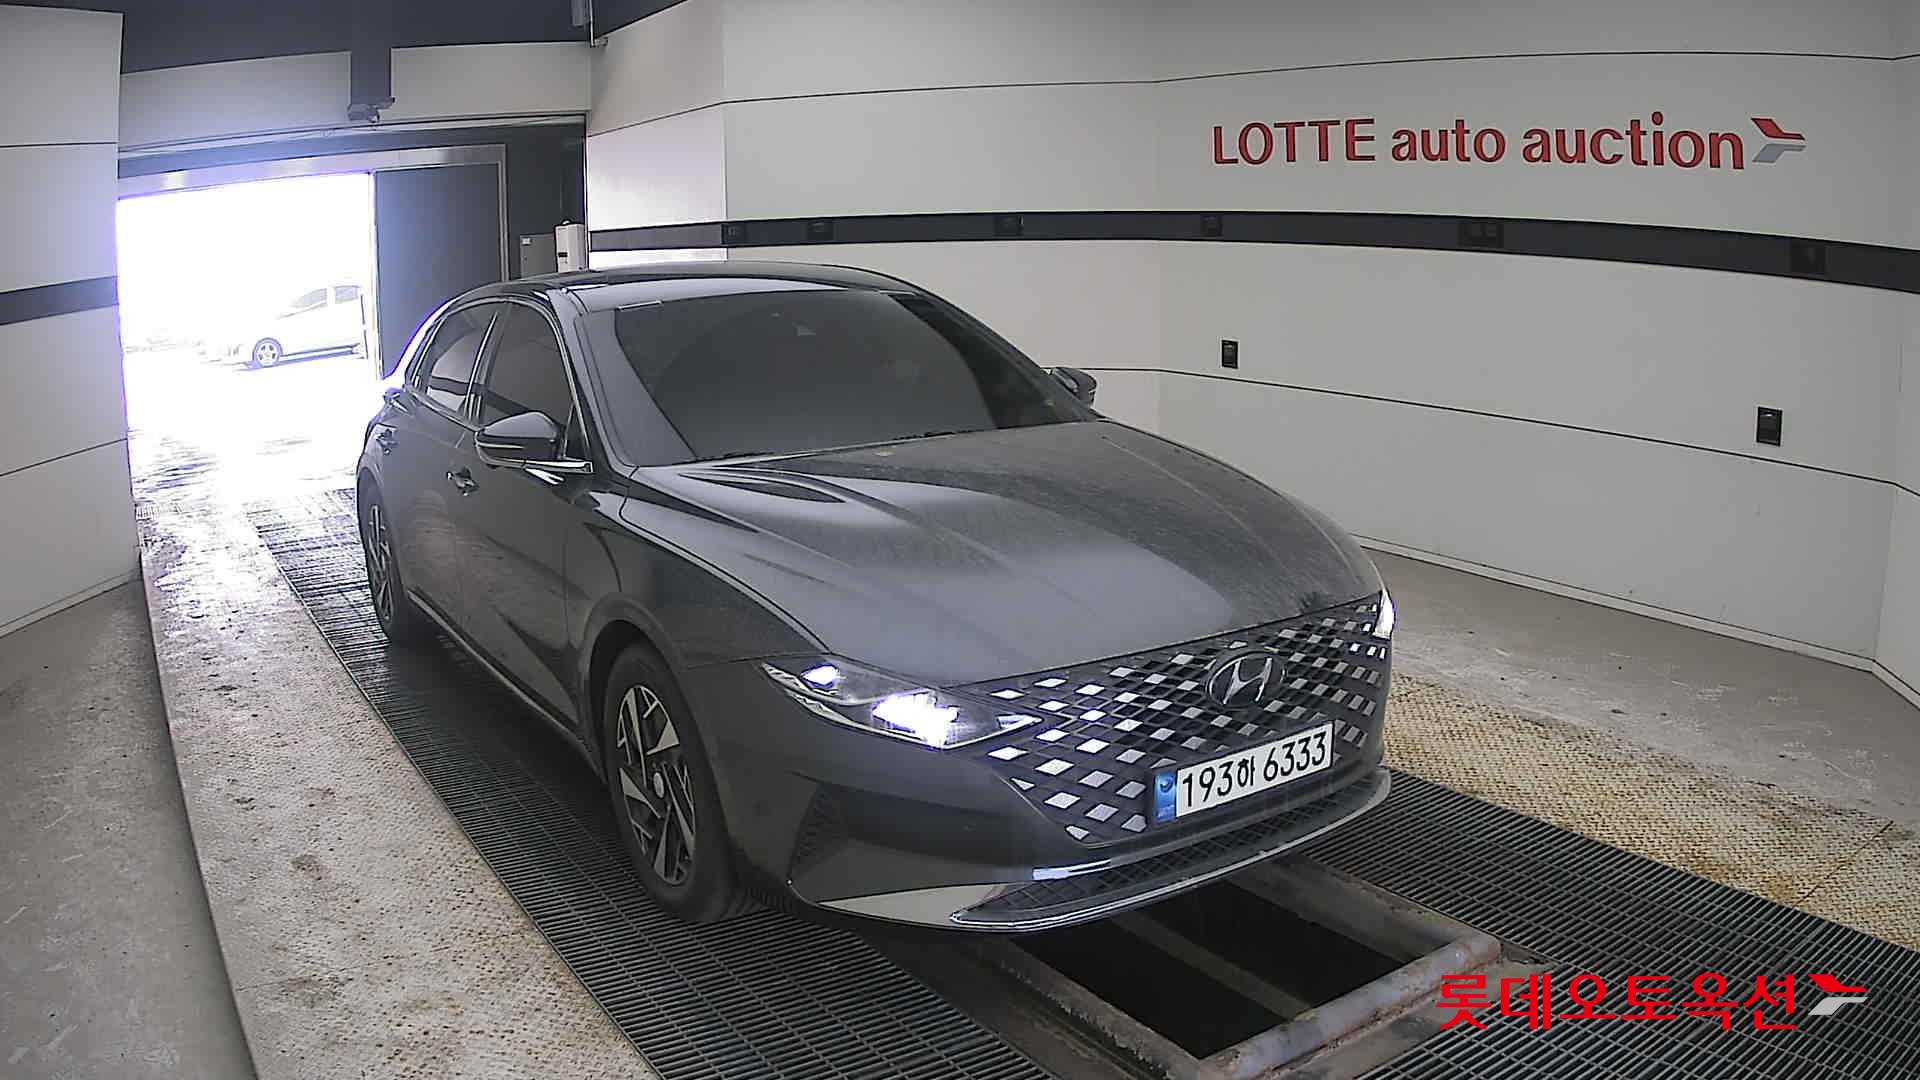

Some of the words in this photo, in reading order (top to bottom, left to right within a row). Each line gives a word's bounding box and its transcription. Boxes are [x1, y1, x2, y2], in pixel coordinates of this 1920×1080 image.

[1213, 118, 1375, 164] LOTTE
[1392, 119, 1506, 163] auto
[1522, 111, 1745, 170] auction
[1182, 756, 1256, 808] 193하
[1263, 731, 1327, 782] 6333
